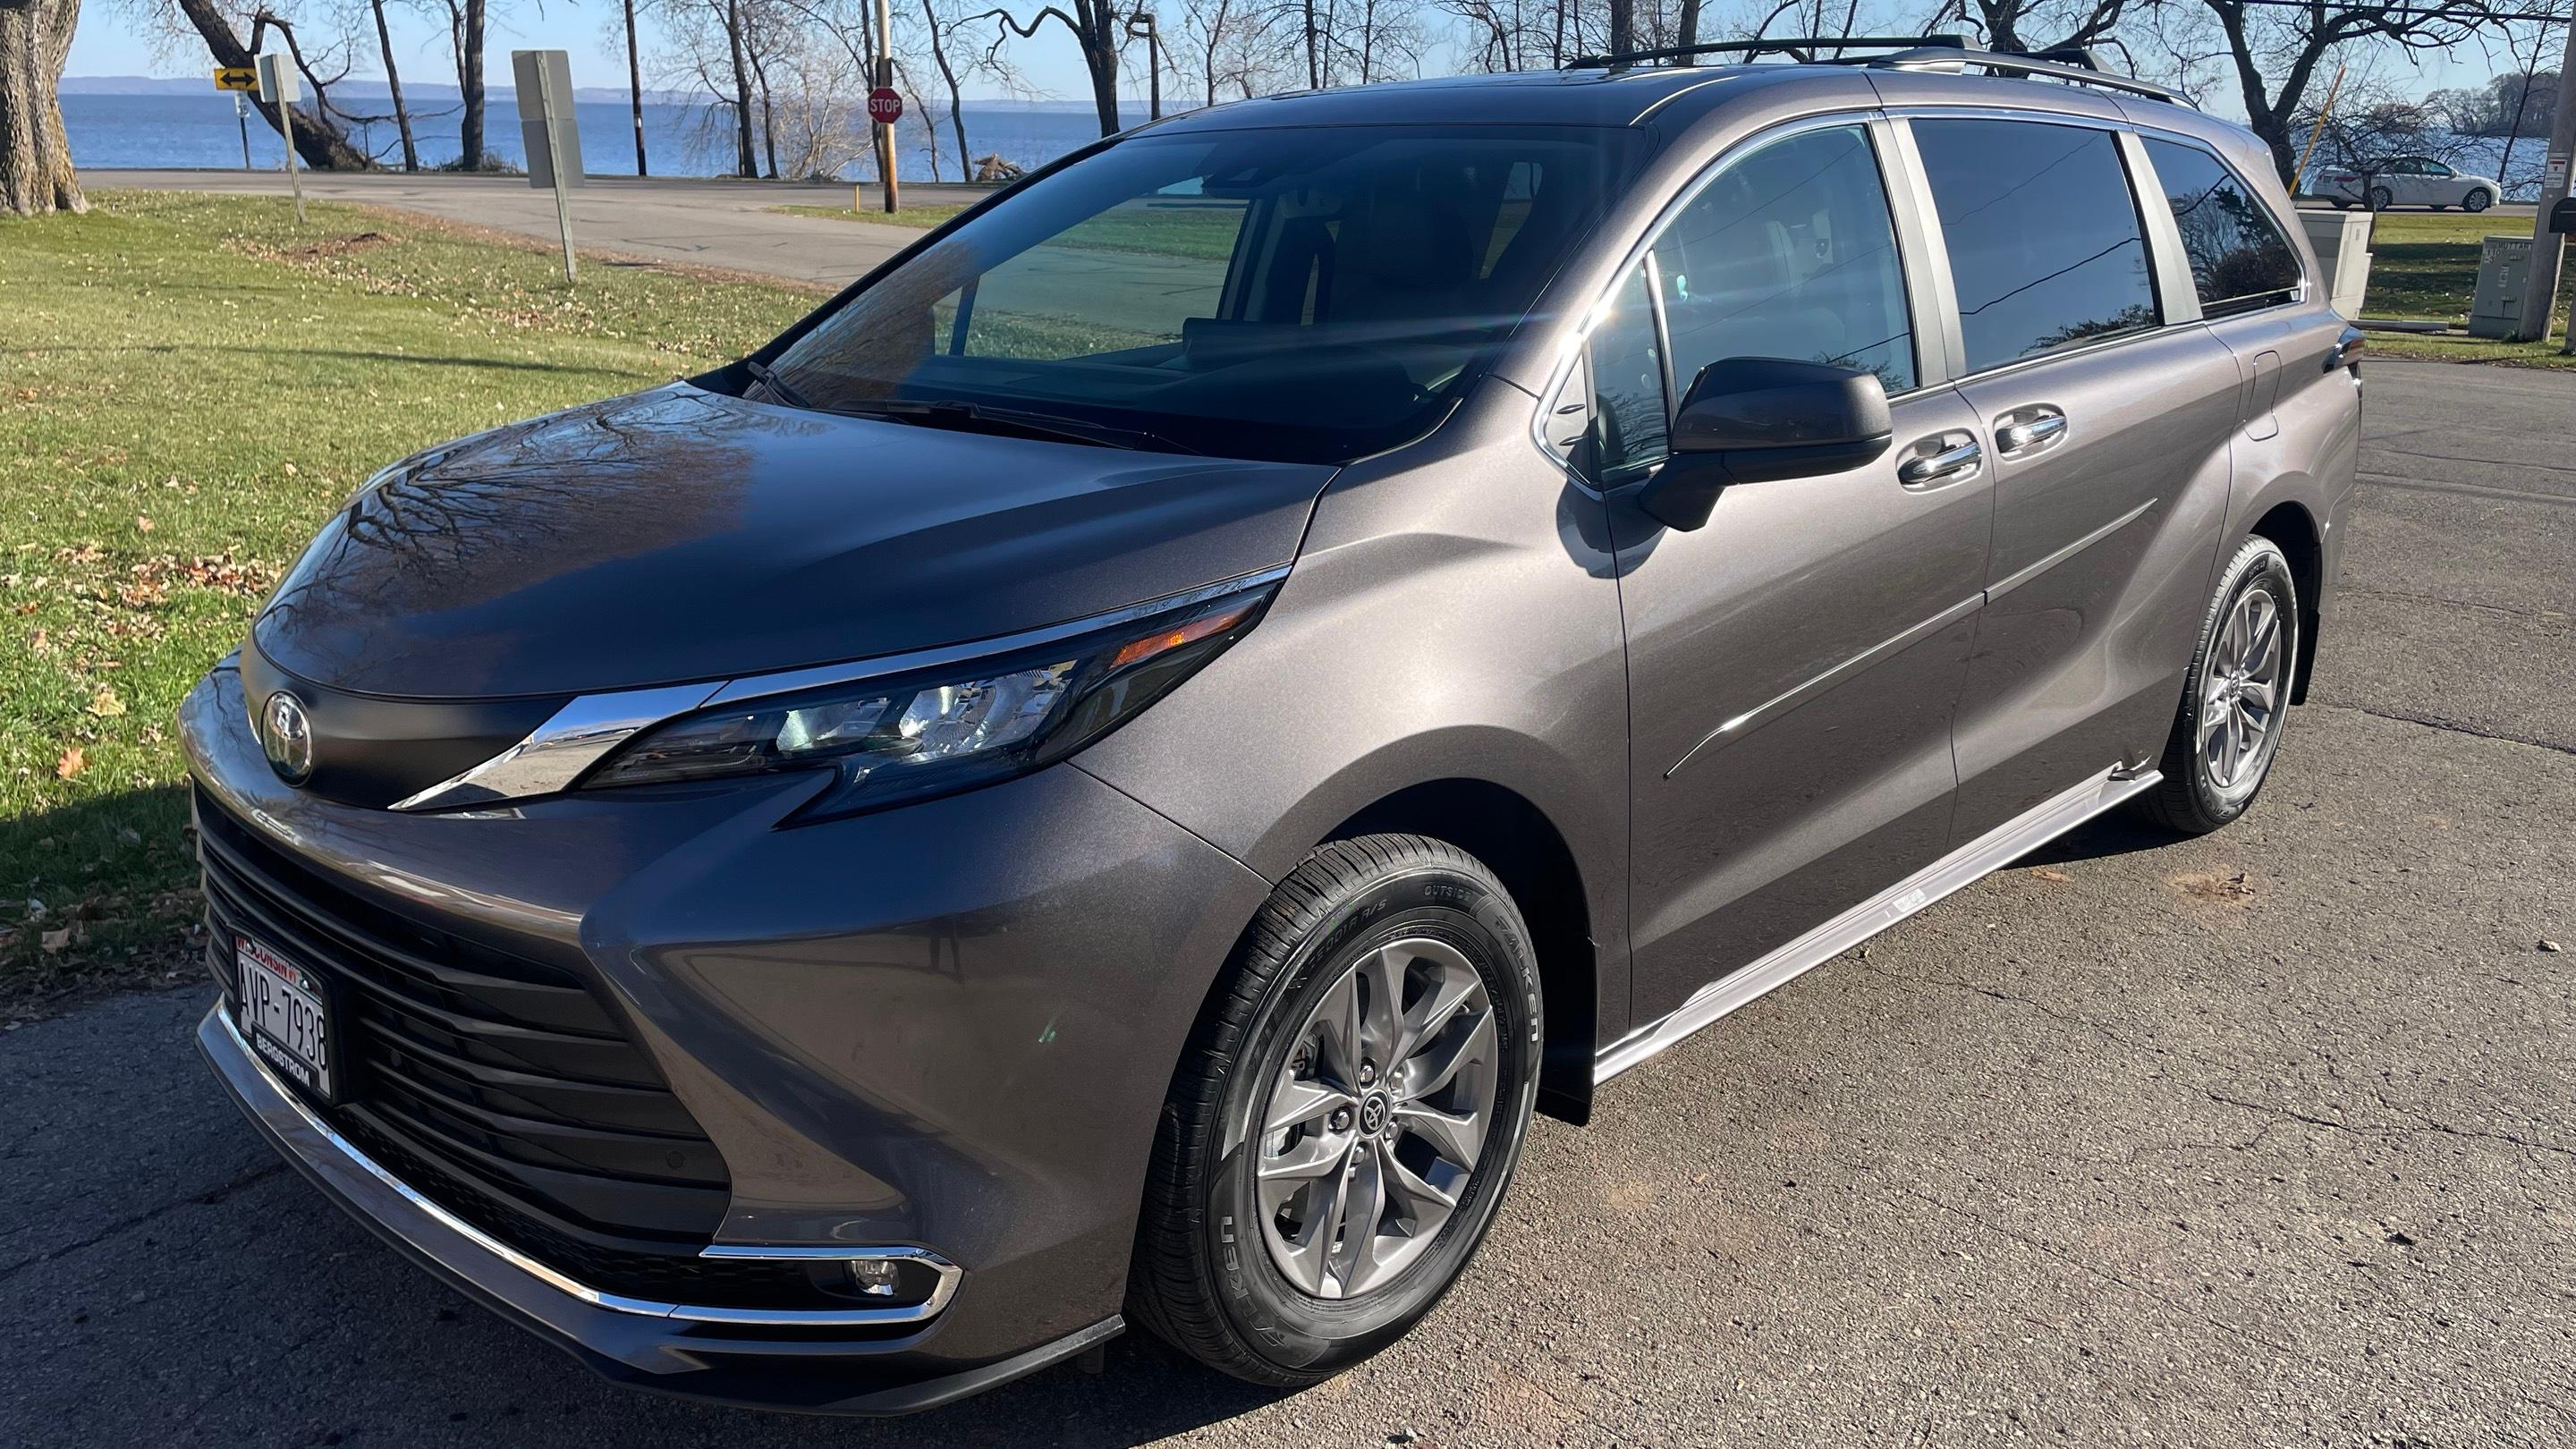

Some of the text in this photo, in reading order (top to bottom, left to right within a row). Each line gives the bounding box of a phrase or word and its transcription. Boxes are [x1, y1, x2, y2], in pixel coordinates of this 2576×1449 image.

[869, 98, 900, 113] STOP
[236, 936, 288, 979] WCONSIN
[240, 961, 328, 1071] AVP-7938
[256, 1033, 310, 1088] BERGSTROM
